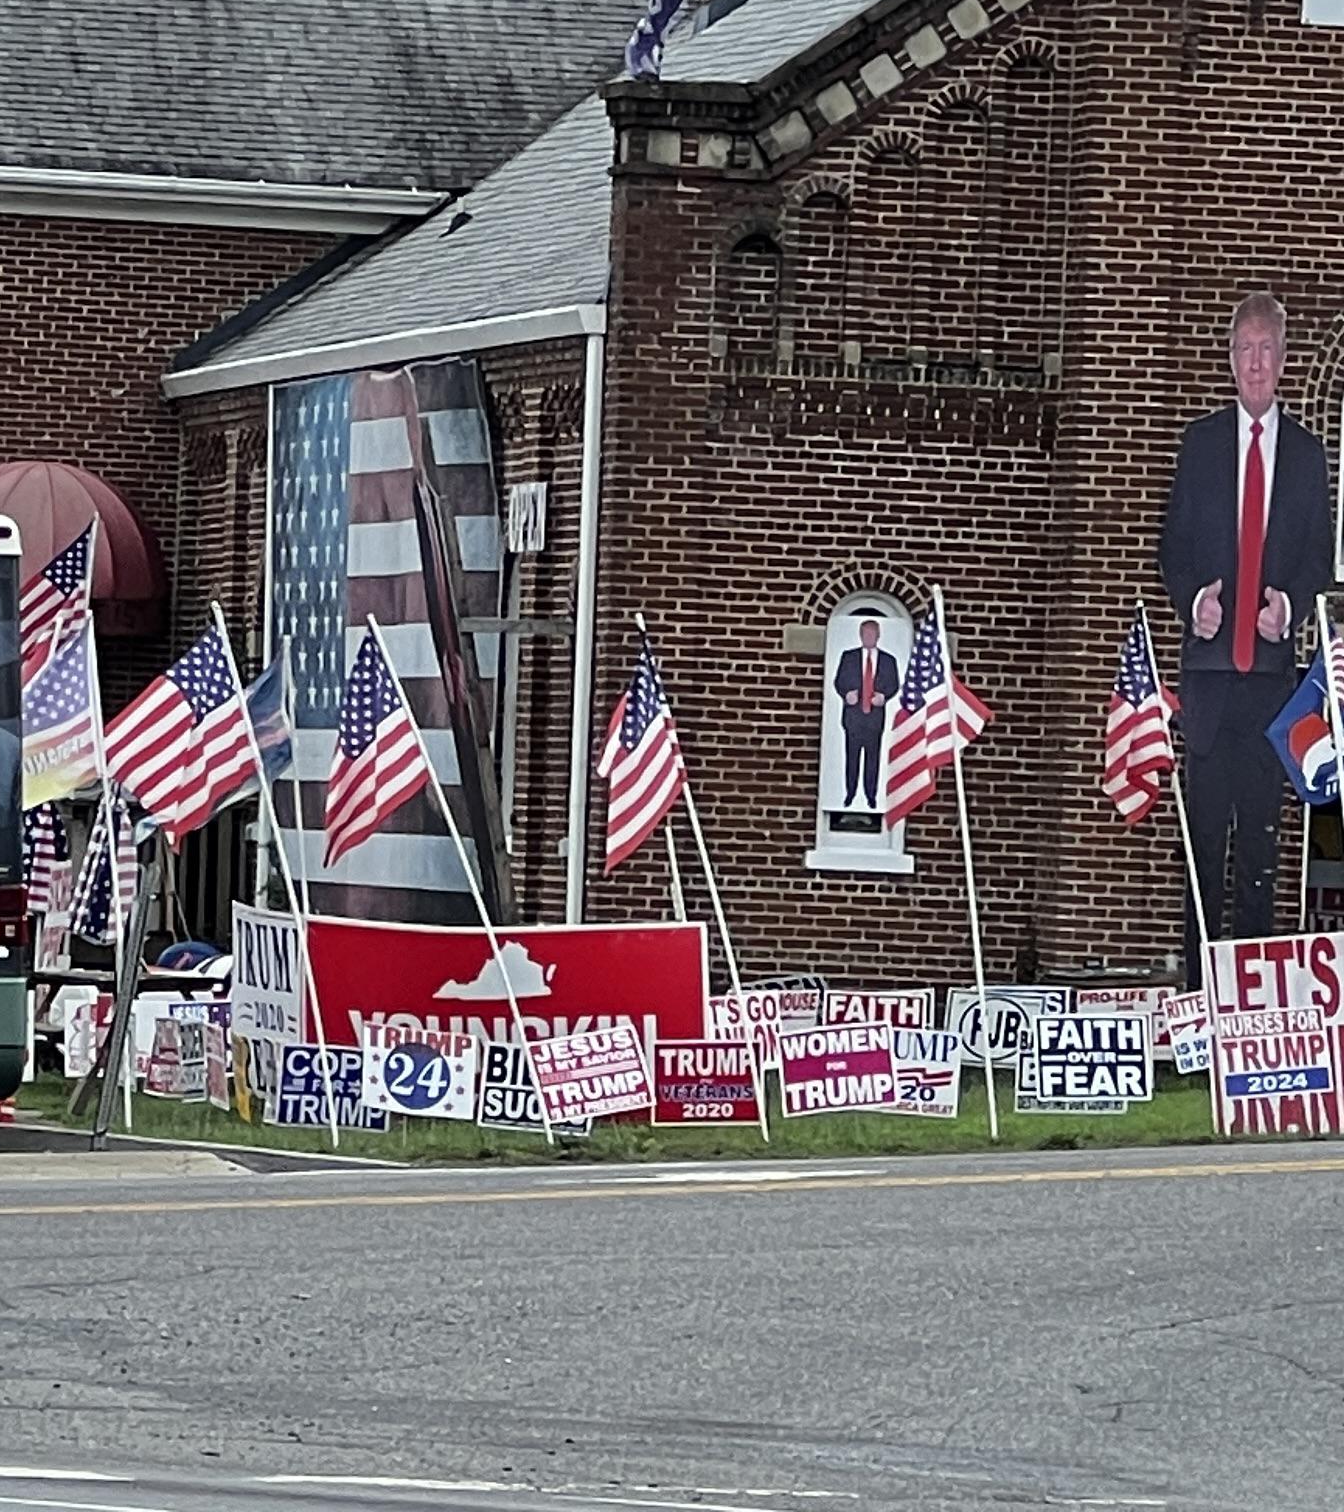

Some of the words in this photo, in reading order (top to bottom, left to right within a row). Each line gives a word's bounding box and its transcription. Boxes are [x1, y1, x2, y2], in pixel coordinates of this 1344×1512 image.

[236, 918, 298, 993] TRUM
[1208, 936, 1341, 1018] LET'S
[747, 995, 777, 1023] GO
[828, 995, 921, 1028] FAITH
[1079, 990, 1149, 1004] PRO-LIFE
[363, 1024, 471, 1058] TRUMP
[1039, 1018, 1143, 1051] FAITH
[1219, 1016, 1285, 1039] NURSES
[1288, 1012, 1321, 1035] FOR
[534, 1029, 634, 1064] JESUS
[782, 1026, 890, 1062] WOMEN
[894, 1029, 958, 1063] UMP
[1067, 1051, 1117, 1064] OVER
[1222, 1036, 1326, 1073] TRUMP
[286, 1049, 362, 1079] COP
[388, 1052, 448, 1099] 24
[658, 1048, 752, 1077] TRUMP
[542, 1069, 645, 1107] TRUMP
[660, 1084, 755, 1101] VETERANS
[786, 1073, 895, 1111] TRUMP
[1041, 1065, 1145, 1096] FEAR
[1247, 1072, 1309, 1092] 2024
[282, 1093, 385, 1128] TRUMP
[682, 1102, 735, 1119] 2020
